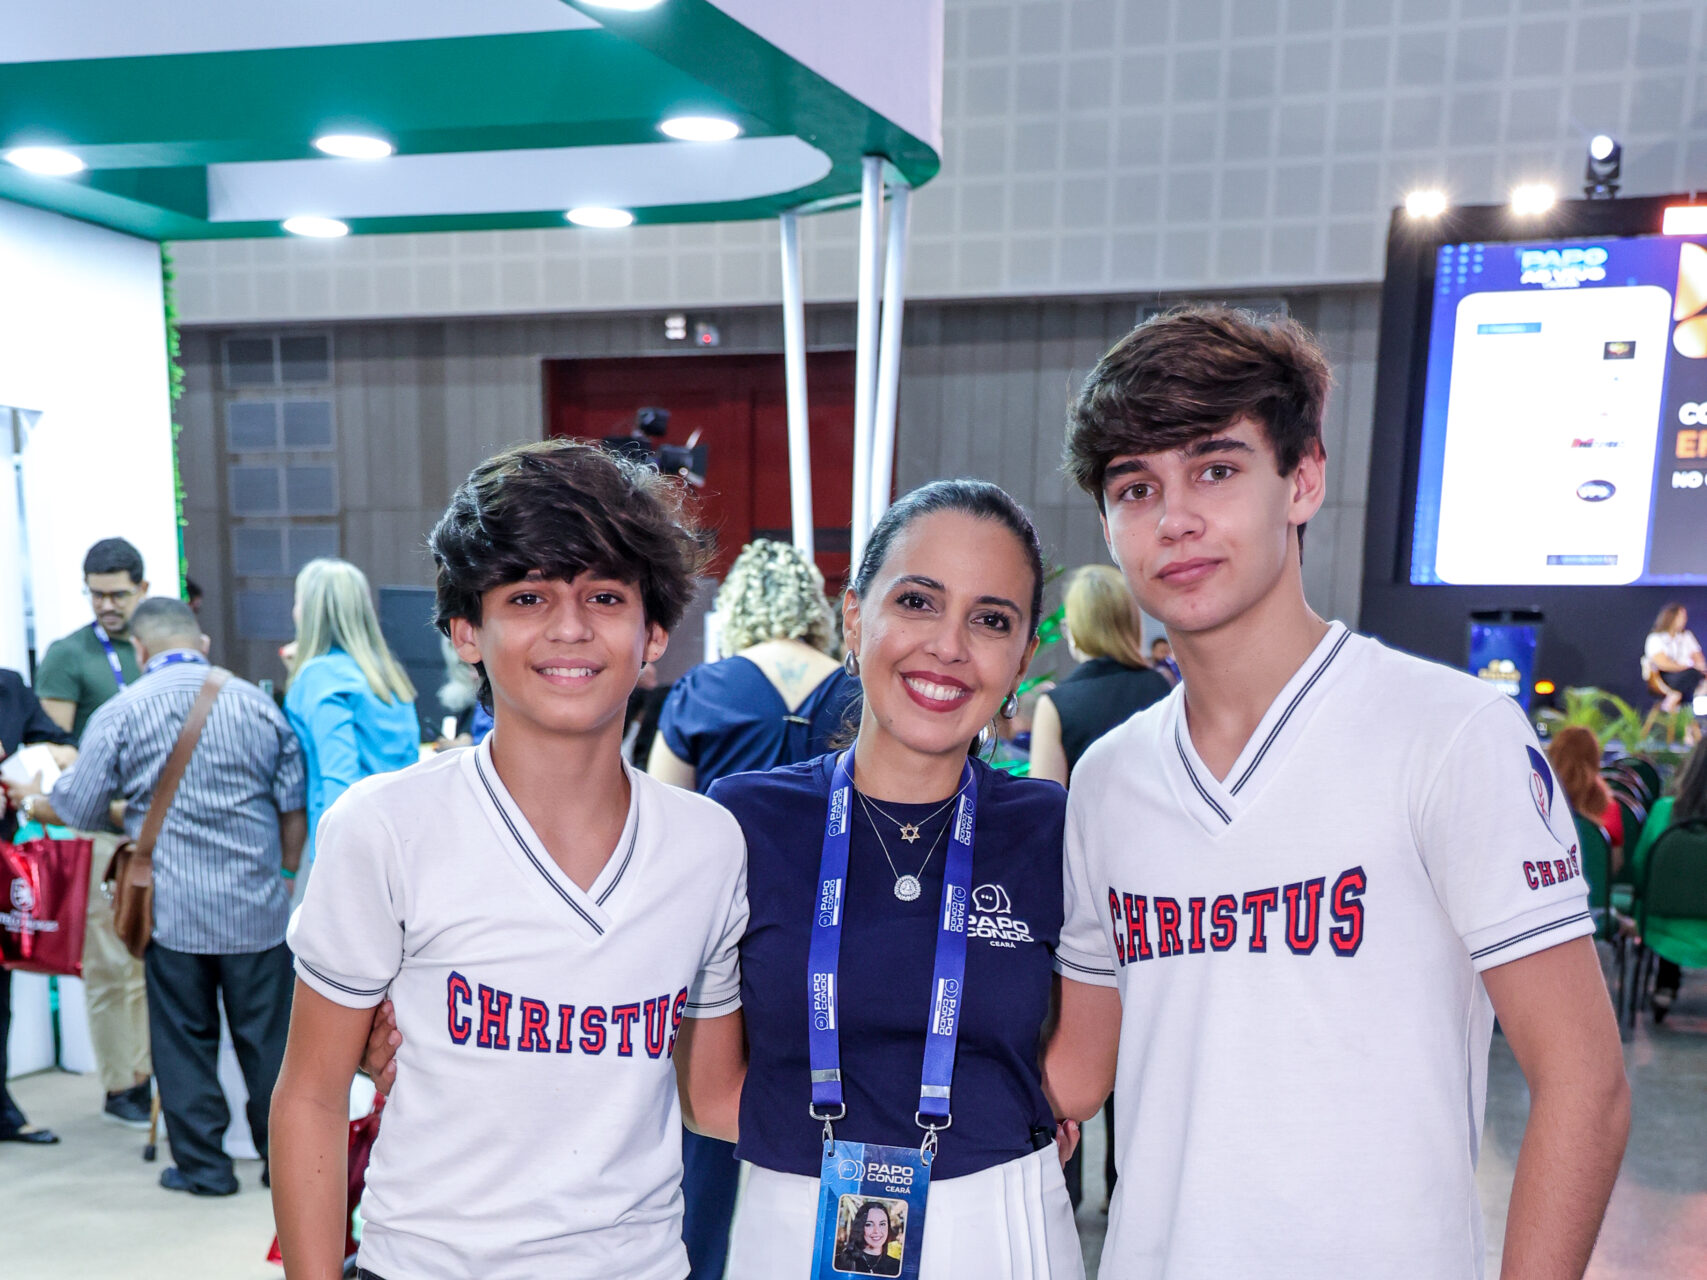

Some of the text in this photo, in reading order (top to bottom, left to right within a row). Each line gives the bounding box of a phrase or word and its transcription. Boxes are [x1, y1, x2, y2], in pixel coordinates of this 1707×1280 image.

[830, 789, 839, 821] PAPO
[963, 815, 973, 846] PAPO
[820, 880, 830, 911] PAPO
[828, 879, 836, 910] CONDO
[950, 901, 958, 932] CONDO
[956, 903, 965, 933] PAPO
[1108, 865, 1367, 967] CHRISTUS
[813, 972, 821, 1011] PAPO
[820, 972, 828, 1010] CONDO
[939, 998, 949, 1035] CONDO
[945, 999, 957, 1036] PAPO
[867, 1162, 914, 1177] PAPO
[867, 1173, 913, 1186] CONDO
[885, 1185, 911, 1194] CEARÁ
